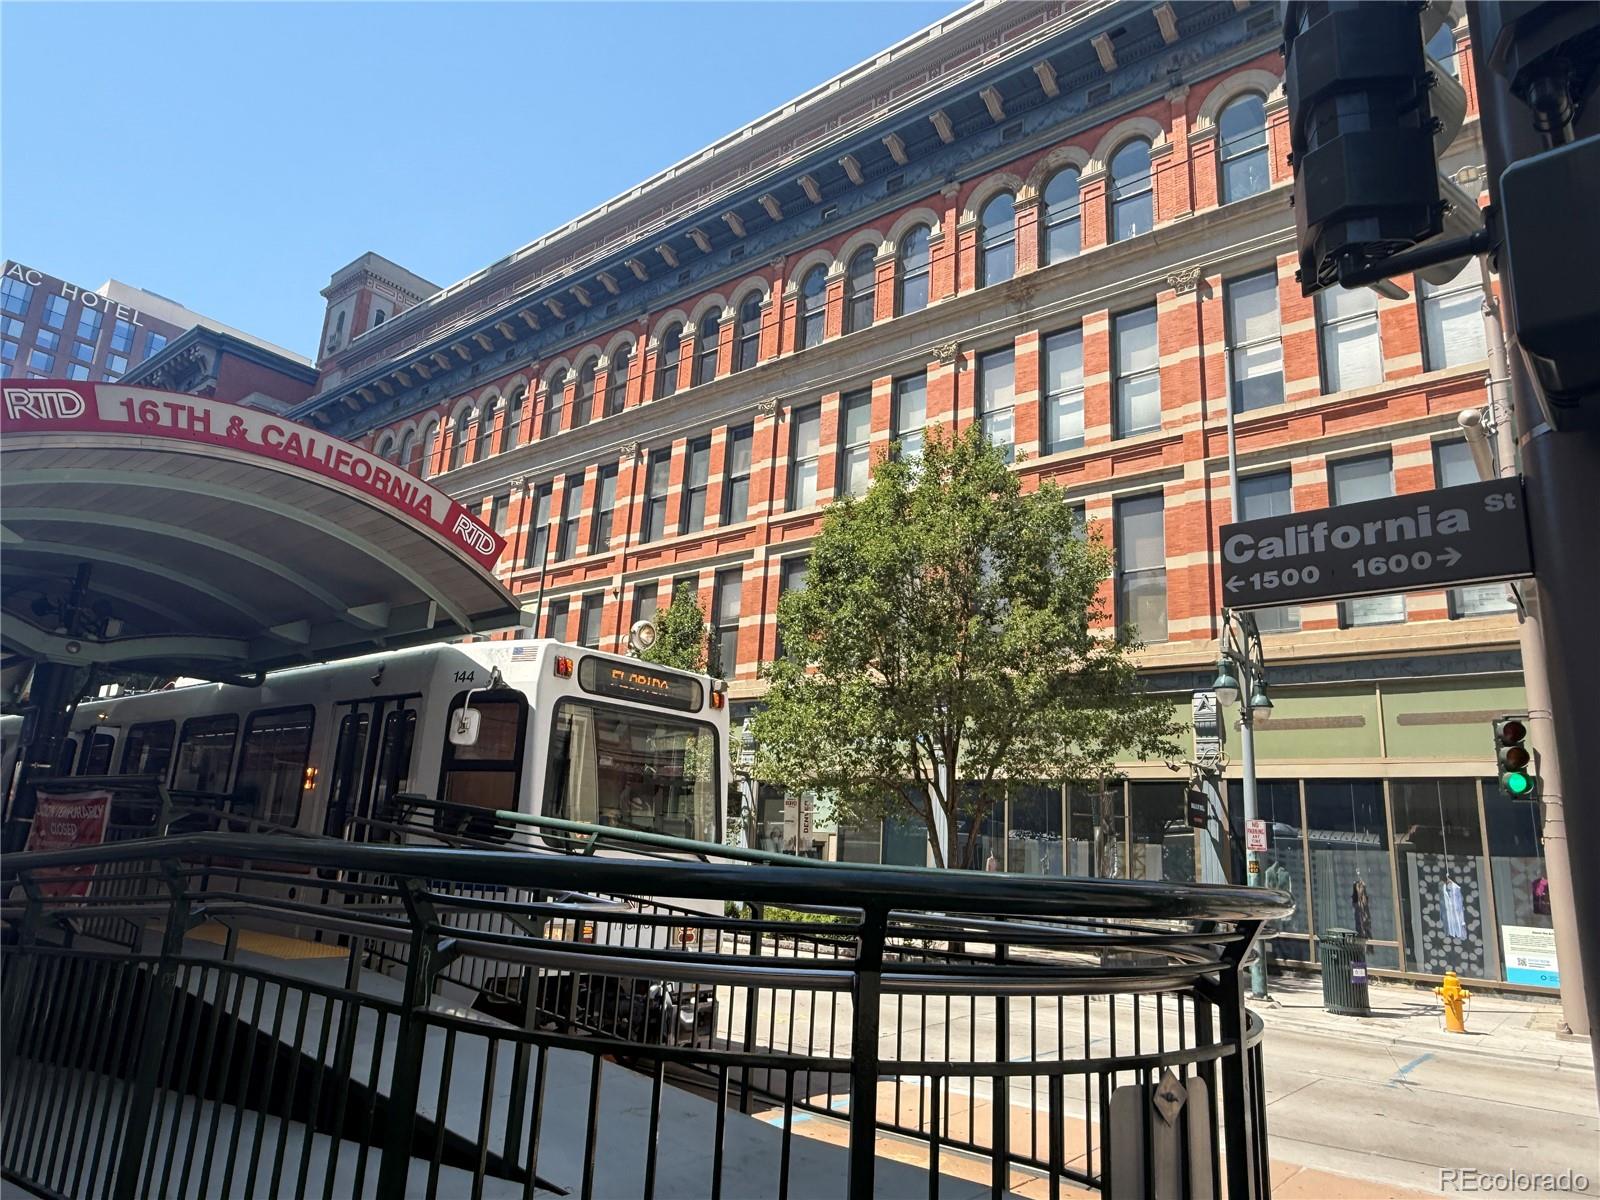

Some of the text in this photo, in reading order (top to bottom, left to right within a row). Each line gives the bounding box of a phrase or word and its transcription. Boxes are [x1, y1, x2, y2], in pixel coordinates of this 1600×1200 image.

[7, 263, 143, 327] AC HOTEL
[4, 388, 85, 420] RTD
[120, 397, 432, 519] 16TH & CALIFORNIA
[452, 513, 495, 556] RTD
[1223, 493, 1517, 564] California St
[1250, 565, 1321, 591] 1500
[1352, 550, 1433, 578] 1600
[453, 670, 475, 683] 144
[50, 823, 78, 836] CLOSED
